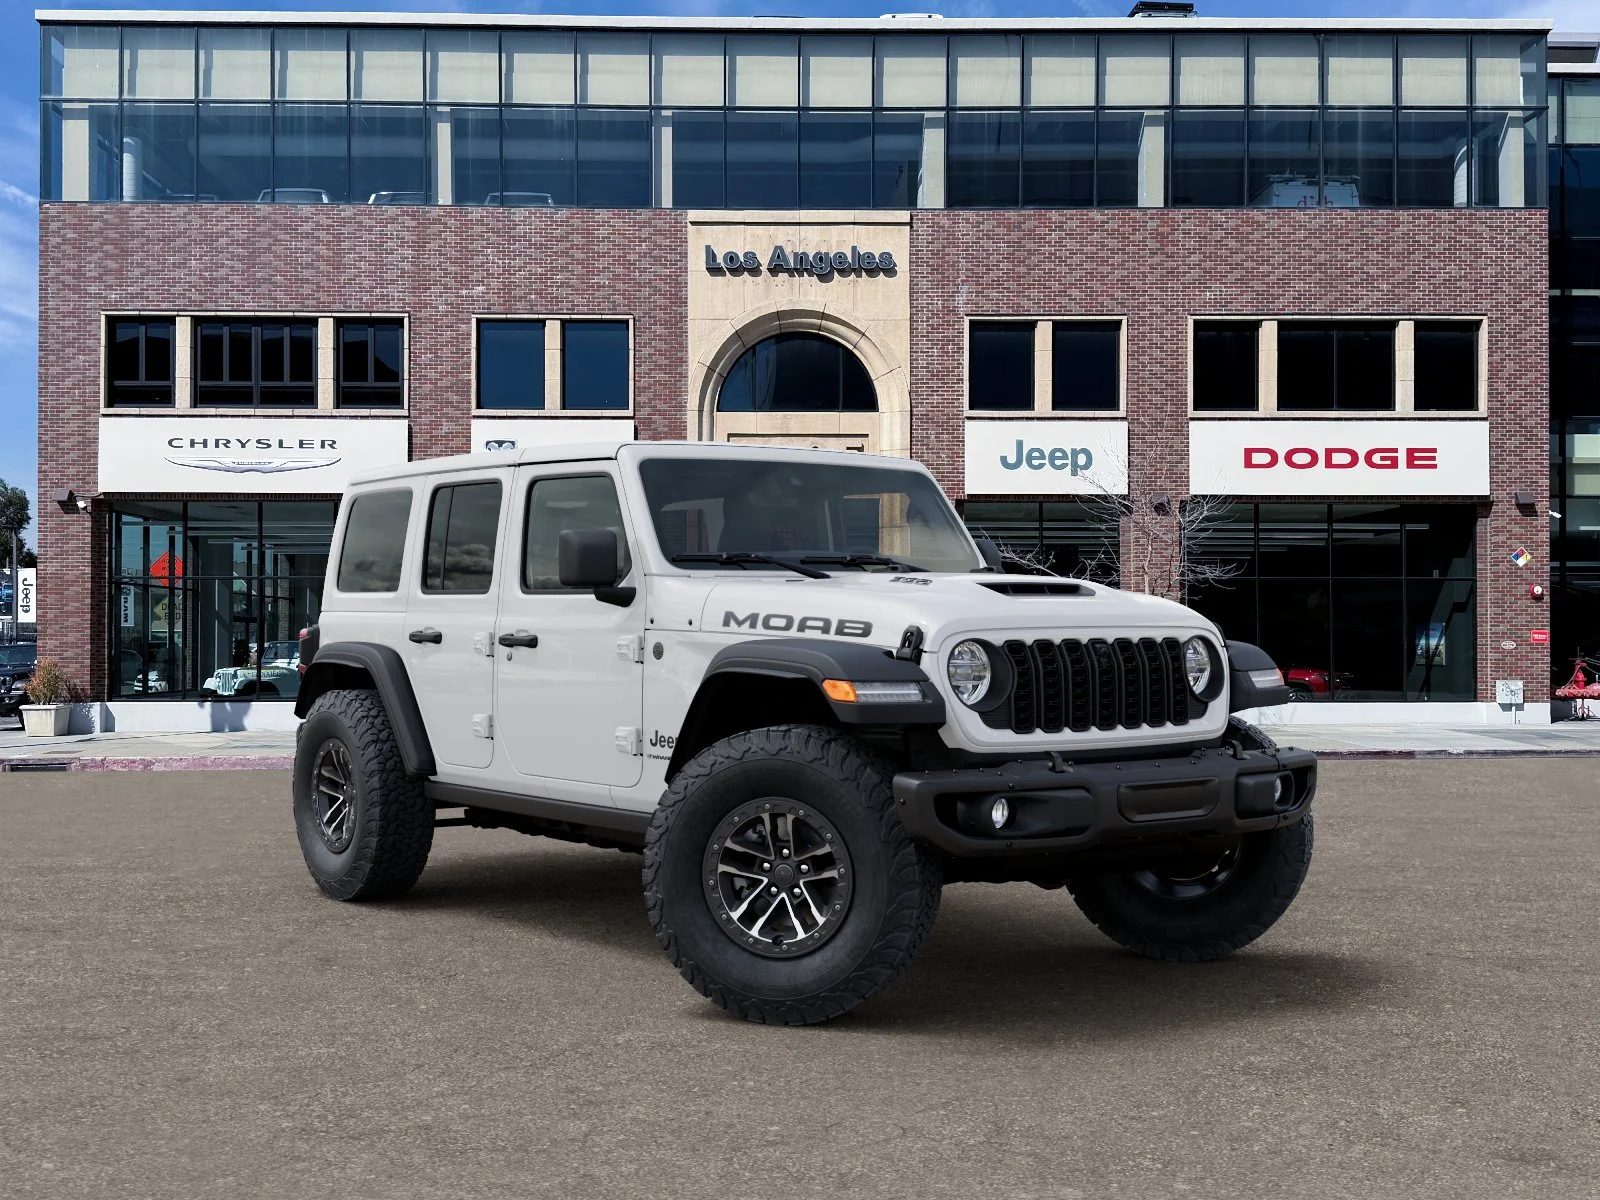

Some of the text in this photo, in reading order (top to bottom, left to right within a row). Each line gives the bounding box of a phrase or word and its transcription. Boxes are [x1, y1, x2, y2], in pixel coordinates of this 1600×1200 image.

[705, 245, 895, 275] Los Angeles
[167, 438, 338, 449] CHRYSLER
[1000, 439, 1093, 476] Jeep
[1244, 448, 1438, 469] DODGE
[20, 578, 33, 613] Jeep
[722, 611, 873, 638] MOAB
